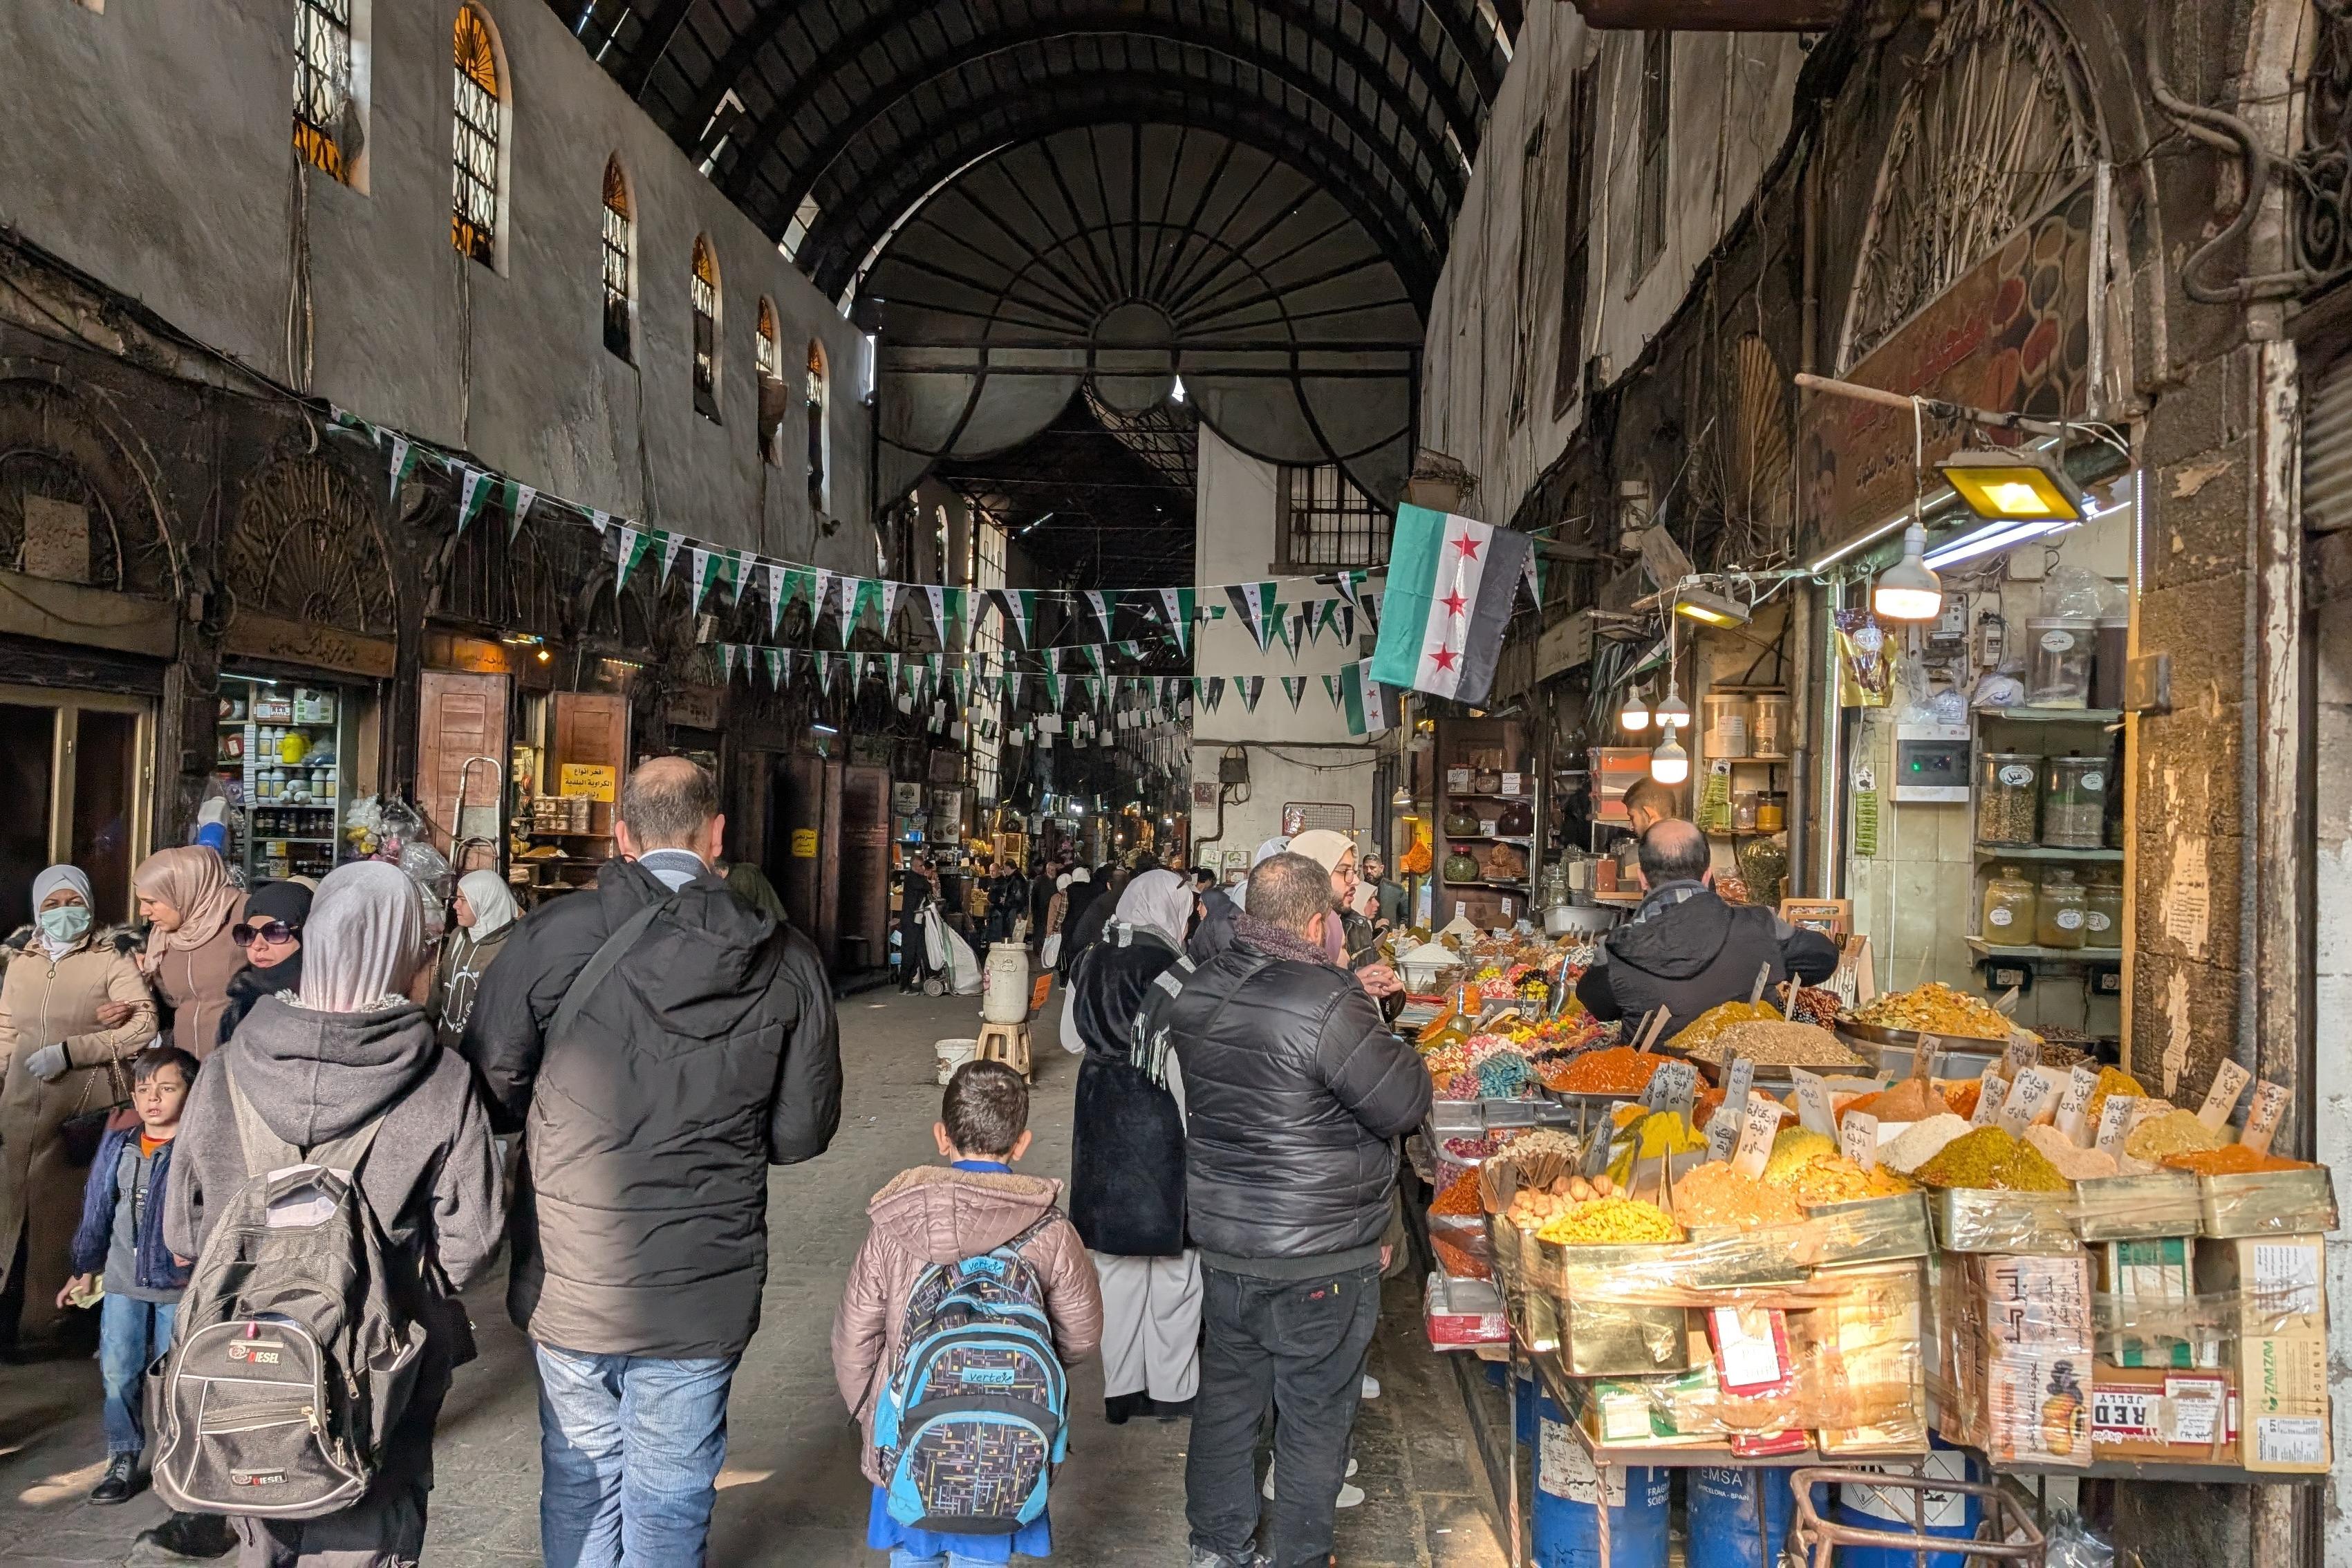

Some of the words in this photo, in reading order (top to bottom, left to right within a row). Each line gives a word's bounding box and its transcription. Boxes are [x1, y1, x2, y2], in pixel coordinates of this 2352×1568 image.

[968, 1260, 1002, 1273] vertex
[248, 1352, 279, 1364] DIESEL
[969, 1372, 1012, 1383] vertex
[2099, 1394, 2143, 1404] JELLY
[2095, 1405, 2147, 1426] RED
[253, 1475, 283, 1486] DIESEL
